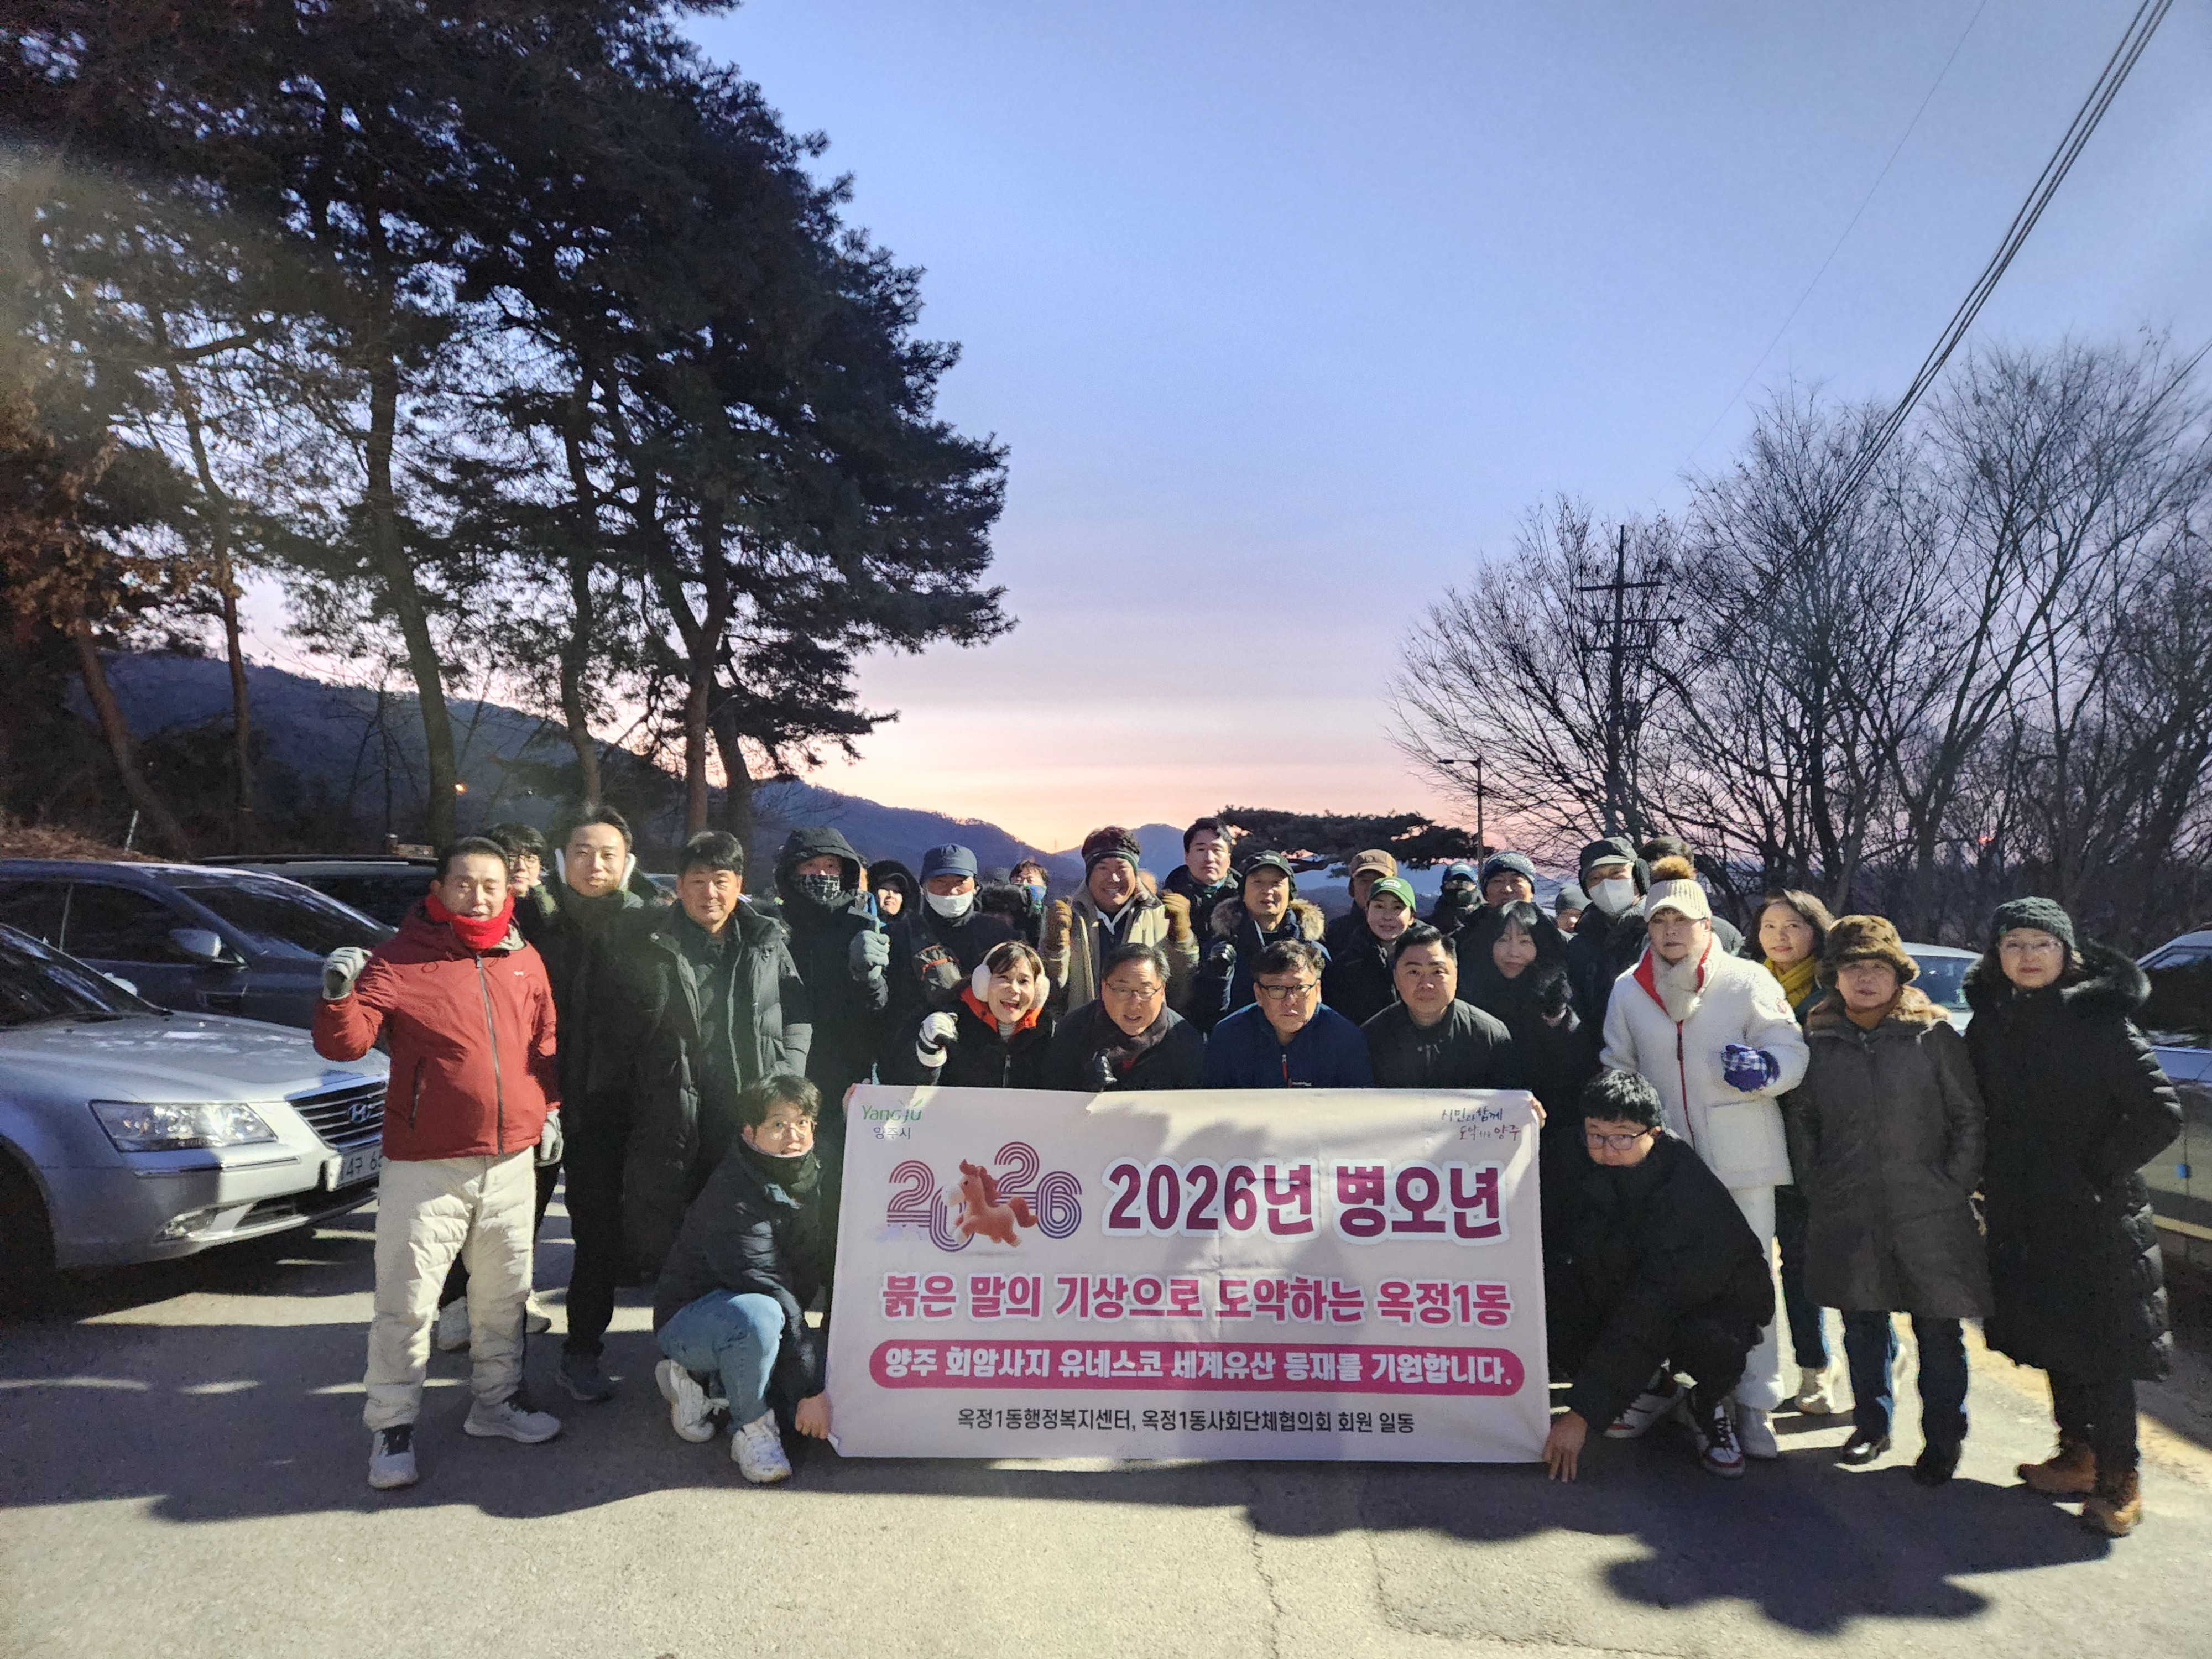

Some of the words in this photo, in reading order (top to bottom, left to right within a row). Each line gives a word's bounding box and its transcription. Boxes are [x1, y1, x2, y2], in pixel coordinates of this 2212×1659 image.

[873, 1127, 910, 1139] 양주시
[1494, 1124, 1520, 1141] 양주
[1109, 1164, 1314, 1235] 2026년
[1336, 1165, 1502, 1239] 병오년
[883, 1275, 956, 1318] 붉은
[970, 1276, 1041, 1318] 말의
[1056, 1276, 1203, 1318] 기상으로
[1215, 1276, 1364, 1323] 도약하는
[1377, 1281, 1511, 1326] 옥정1동
[885, 1348, 937, 1377] 양주
[945, 1346, 1050, 1377] 회암사지
[1058, 1349, 1164, 1378] 유네스코
[1171, 1350, 1276, 1380] 세계유산
[1284, 1352, 1363, 1381] 등재를
[1371, 1353, 1512, 1385] 기원합니다.
[958, 1408, 1136, 1432] 옥정1동행정복지센터,
[1141, 1410, 1332, 1432] 옥정1동사회단체협의회
[1338, 1411, 1373, 1433] 회원
[1379, 1412, 1415, 1433] 일동
